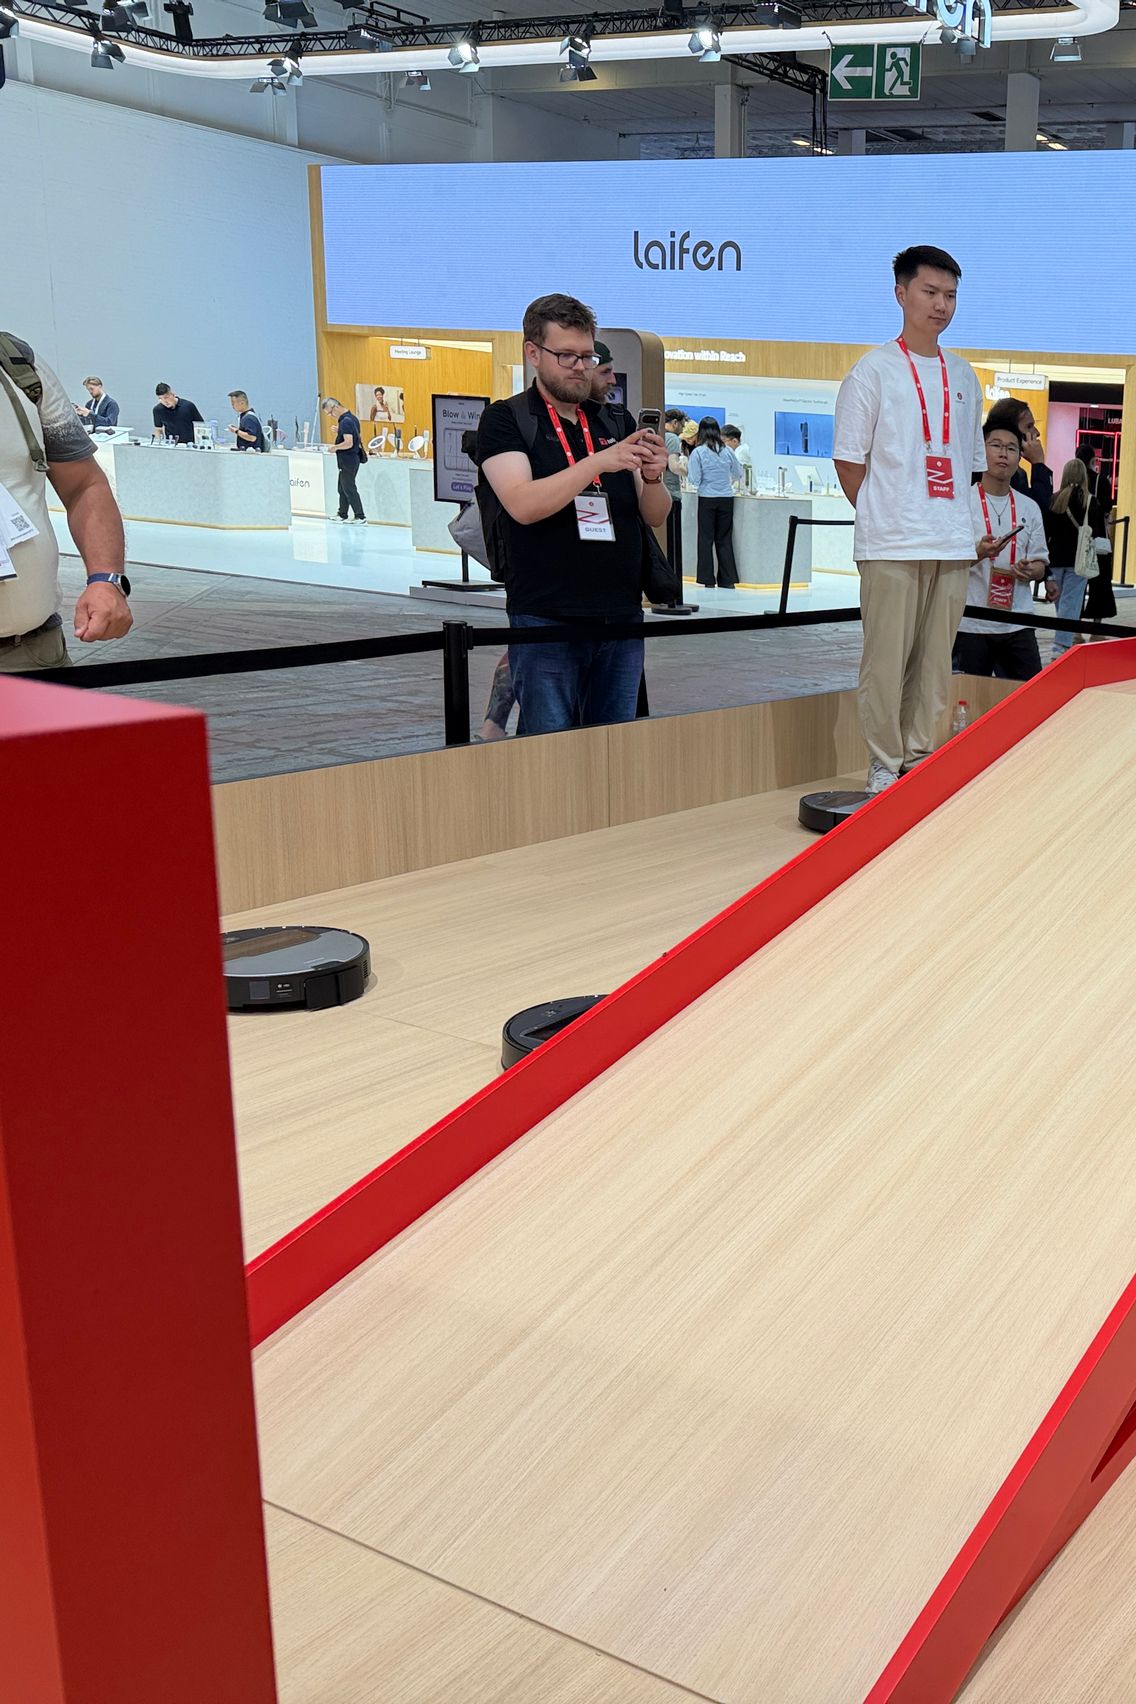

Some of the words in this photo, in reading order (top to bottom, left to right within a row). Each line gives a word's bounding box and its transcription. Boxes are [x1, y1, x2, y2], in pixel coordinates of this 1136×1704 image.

[633, 230, 742, 271] laifen
[719, 351, 746, 362] Reach
[443, 409, 459, 419] Blow
